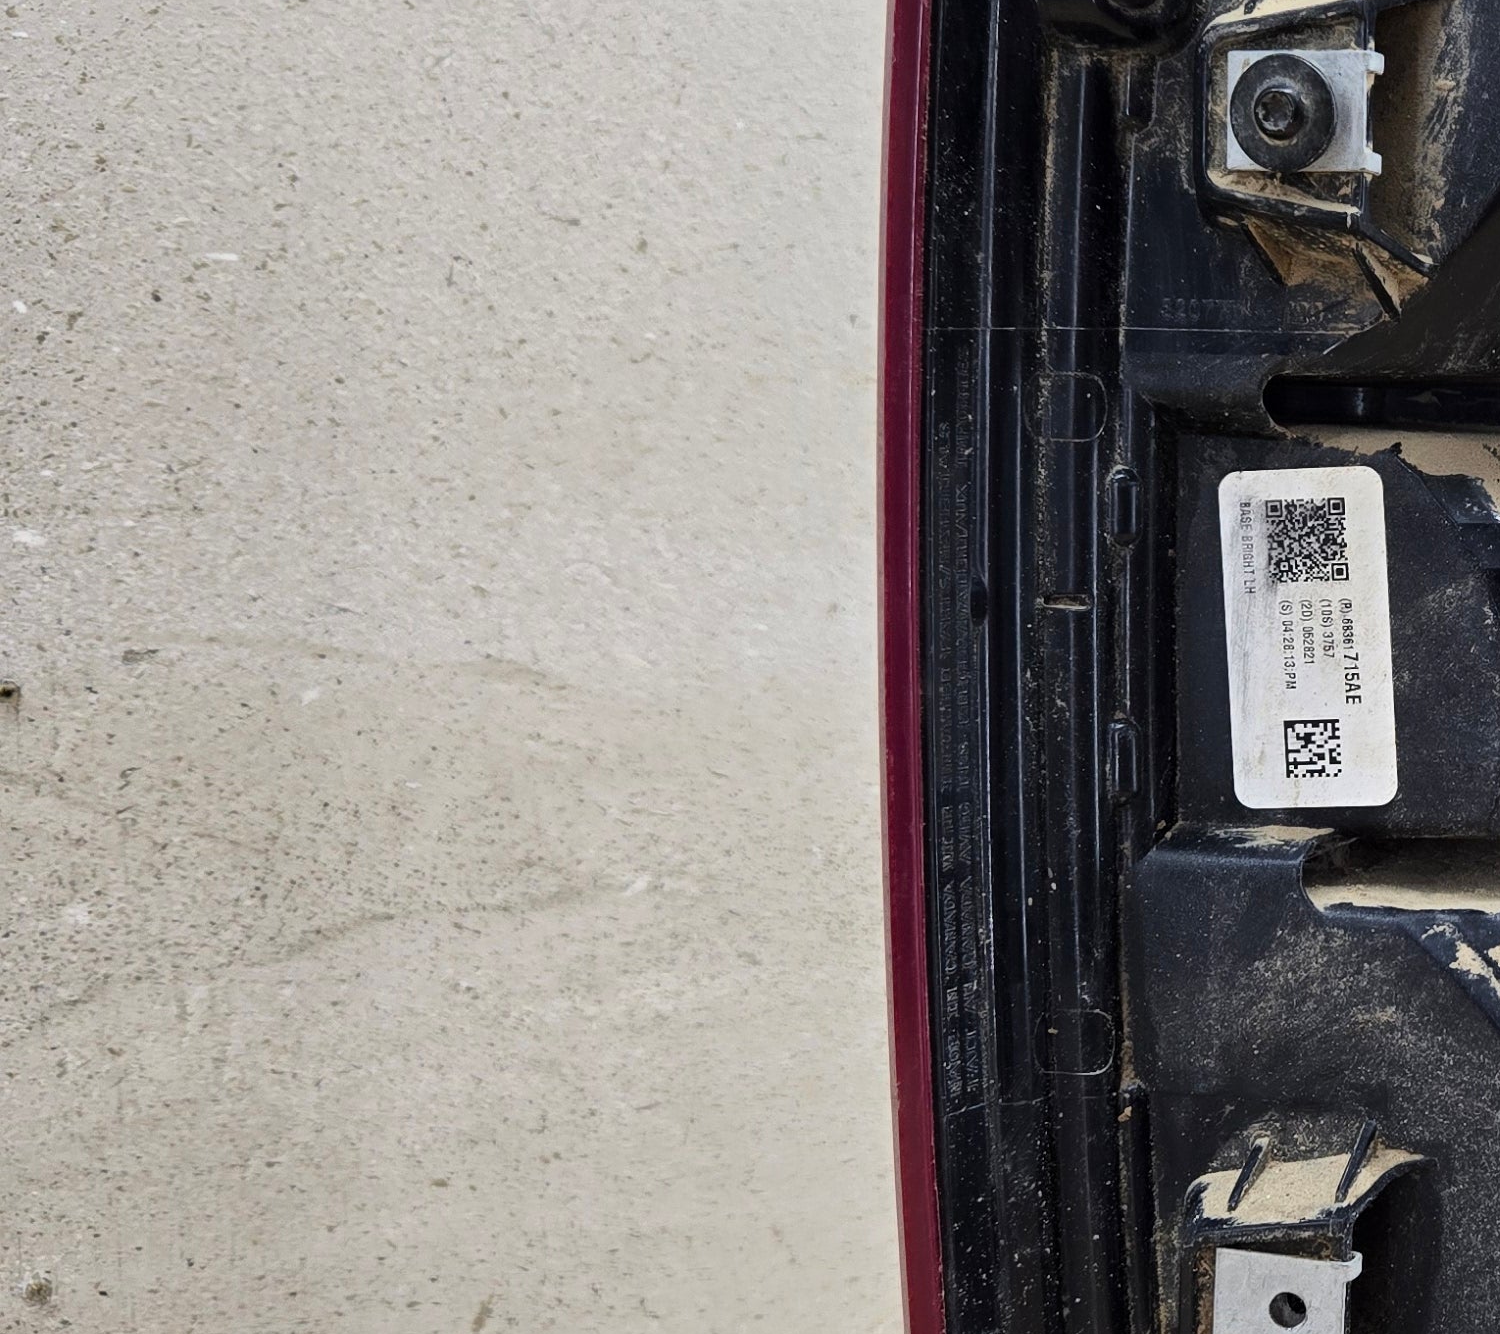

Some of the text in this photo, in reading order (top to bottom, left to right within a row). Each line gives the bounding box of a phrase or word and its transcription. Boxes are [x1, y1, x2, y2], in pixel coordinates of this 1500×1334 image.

[1239, 501, 1256, 594] BASE BRIGHT LH
[1279, 599, 1293, 616] (S)
[1299, 599, 1313, 622] (2D)
[1338, 598, 1352, 614] (P)
[1319, 598, 1335, 658] (10S) 3757
